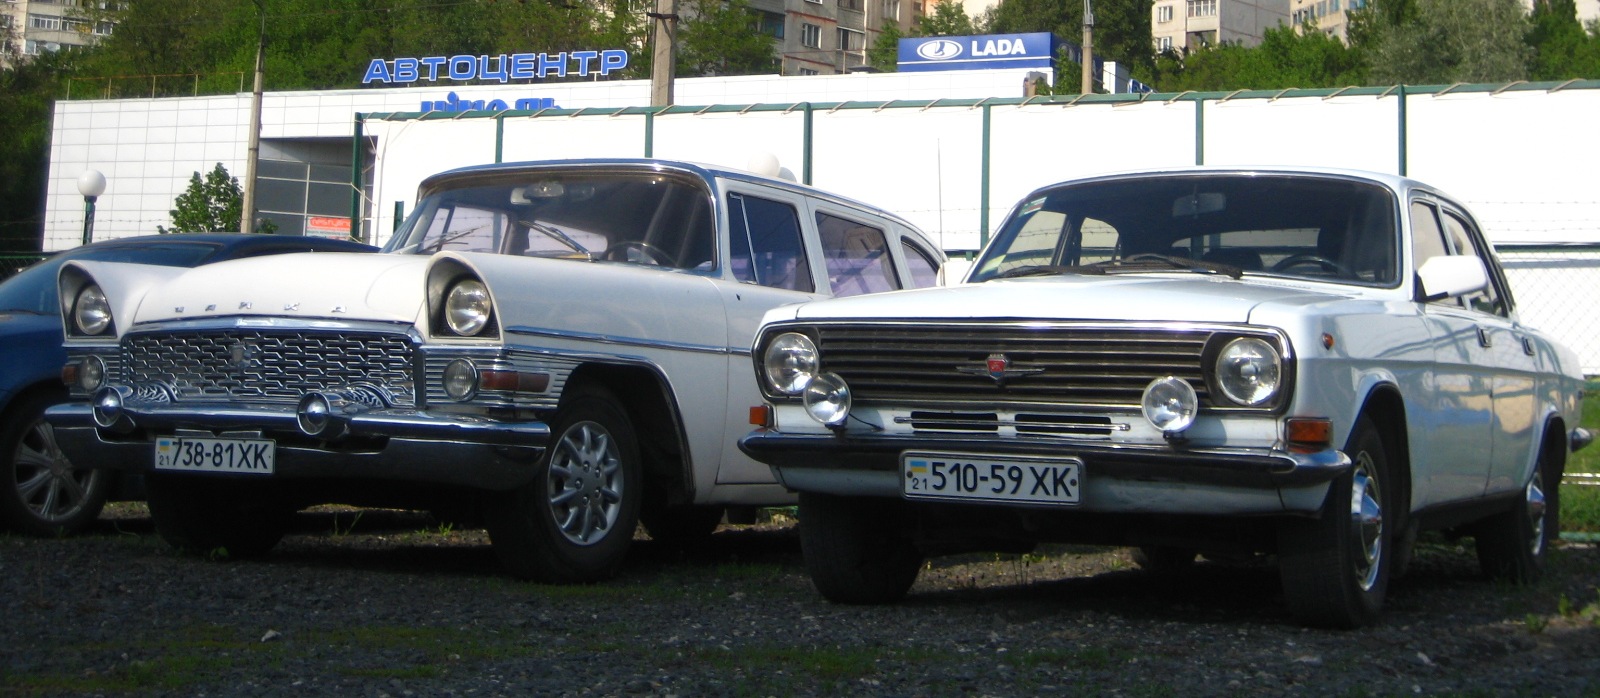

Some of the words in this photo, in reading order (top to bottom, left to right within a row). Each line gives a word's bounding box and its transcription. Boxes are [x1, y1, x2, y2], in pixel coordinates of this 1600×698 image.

[971, 39, 1026, 56] LADA
[362, 50, 628, 83] АВТОЦЕНТР
[912, 477, 928, 490] 21
